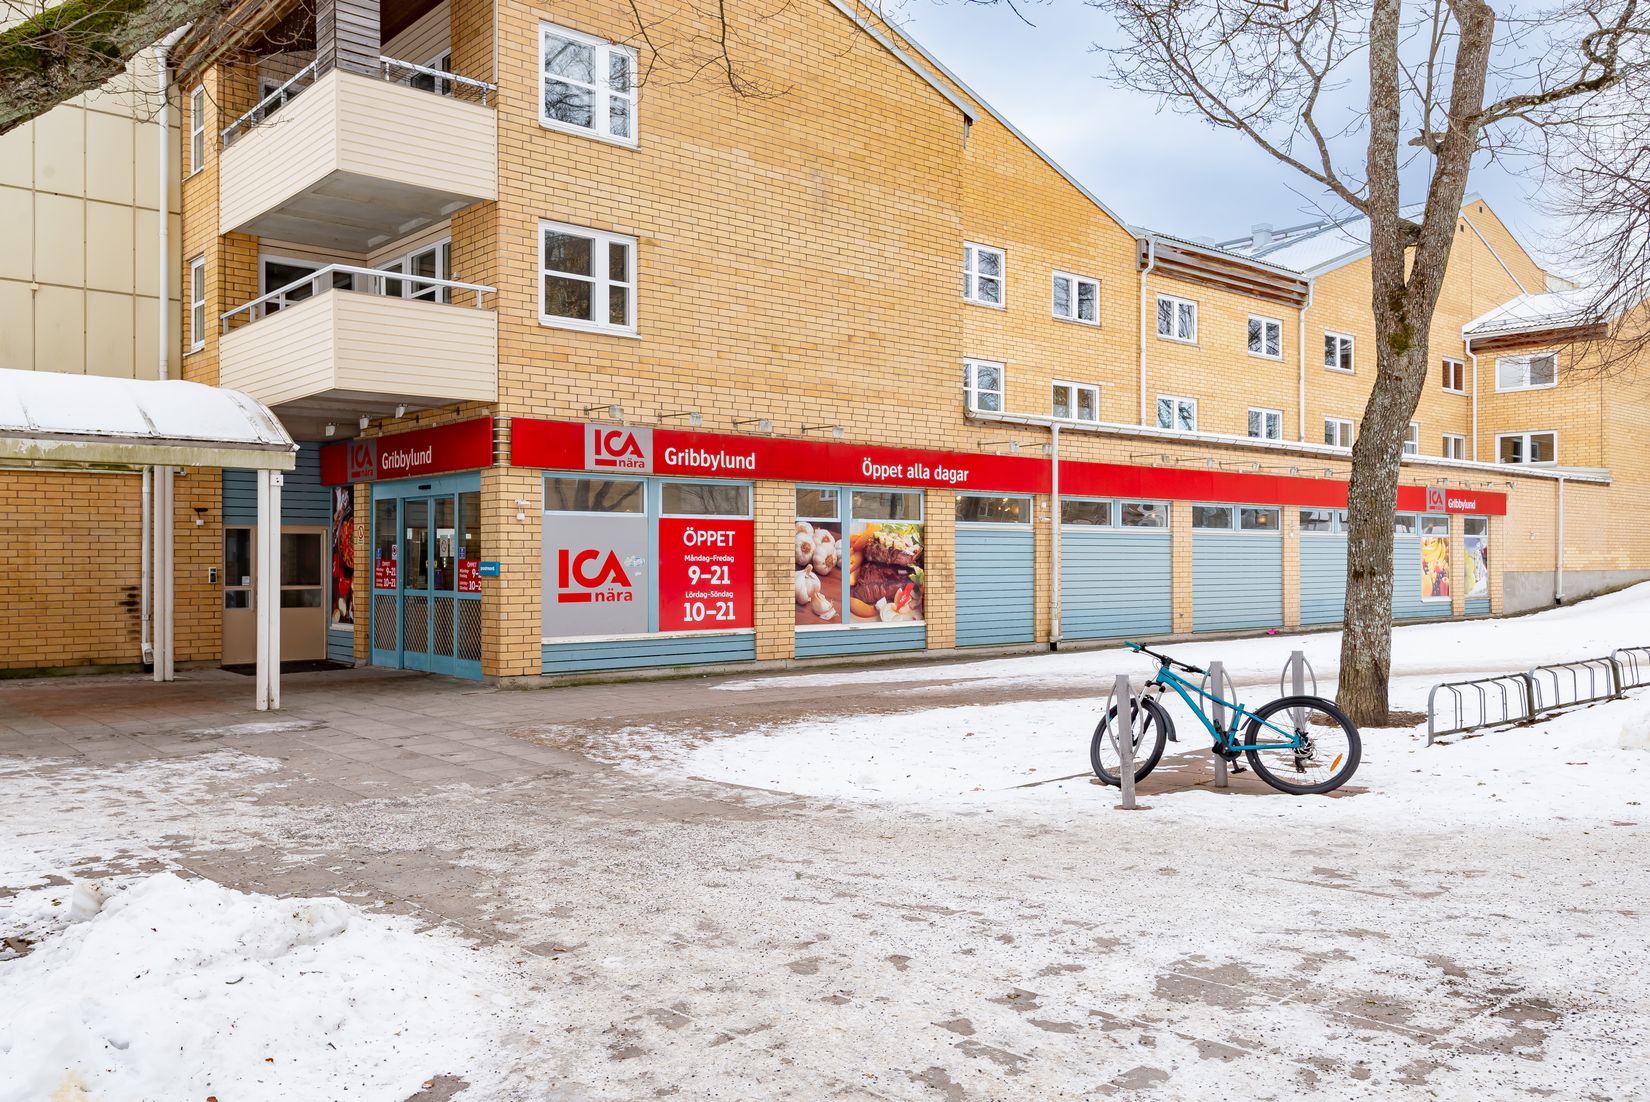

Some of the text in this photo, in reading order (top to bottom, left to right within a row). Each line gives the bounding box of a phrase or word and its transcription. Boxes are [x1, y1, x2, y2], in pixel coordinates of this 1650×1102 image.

[594, 429, 645, 458] ICA
[351, 445, 373, 469] ICA
[382, 445, 432, 470] Gribbylund
[618, 459, 645, 469] nära
[664, 447, 756, 471] Gribbylund
[862, 457, 969, 484] Öppet alla dagar
[1429, 490, 1443, 505] ICA
[1448, 498, 1476, 511] Gribbylund
[683, 526, 736, 547] ÖPPET
[558, 549, 633, 589] ICA
[684, 554, 735, 563] Måndag–Fredag
[688, 565, 731, 585] 9–21
[595, 588, 633, 603] nära
[685, 590, 733, 599] Lördag–Söndag
[683, 601, 736, 622] 10–21
